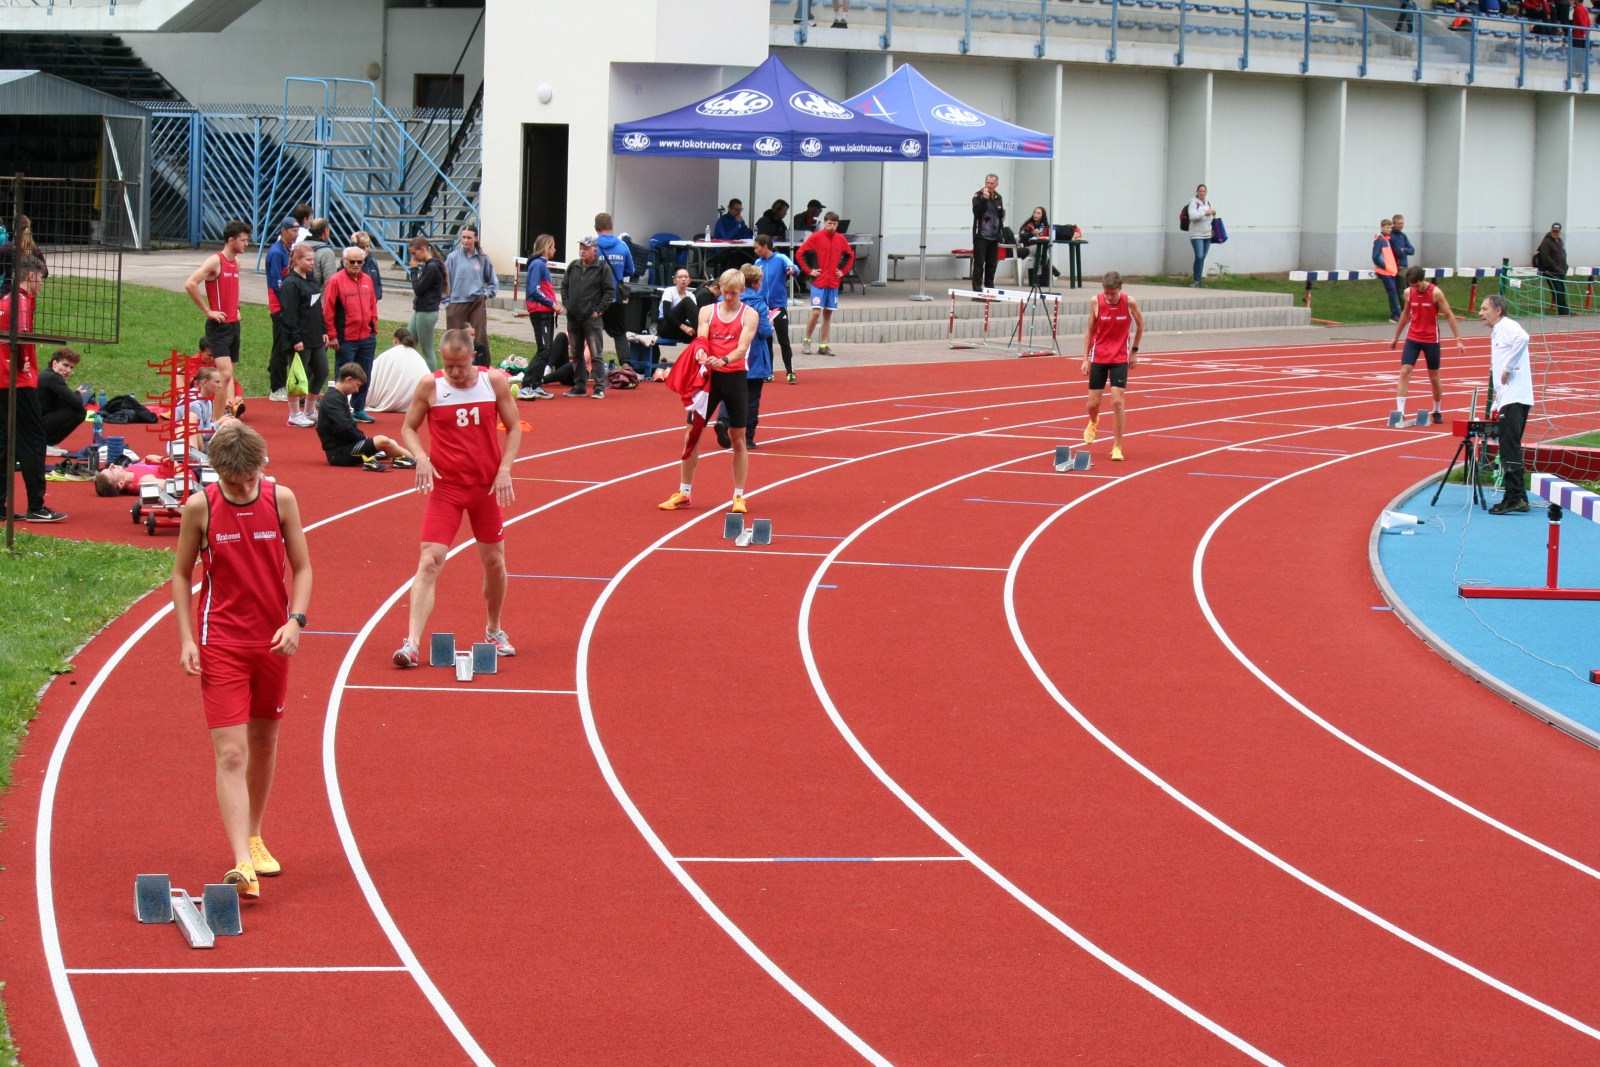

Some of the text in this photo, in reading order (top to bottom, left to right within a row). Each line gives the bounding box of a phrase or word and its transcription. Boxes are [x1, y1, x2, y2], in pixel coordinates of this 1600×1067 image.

[659, 139, 742, 151] www.lokotrutnov.cz
[829, 143, 892, 153] www.lokotrutnov.cz
[993, 141, 1018, 151] PARTNER
[456, 406, 480, 427] 81
